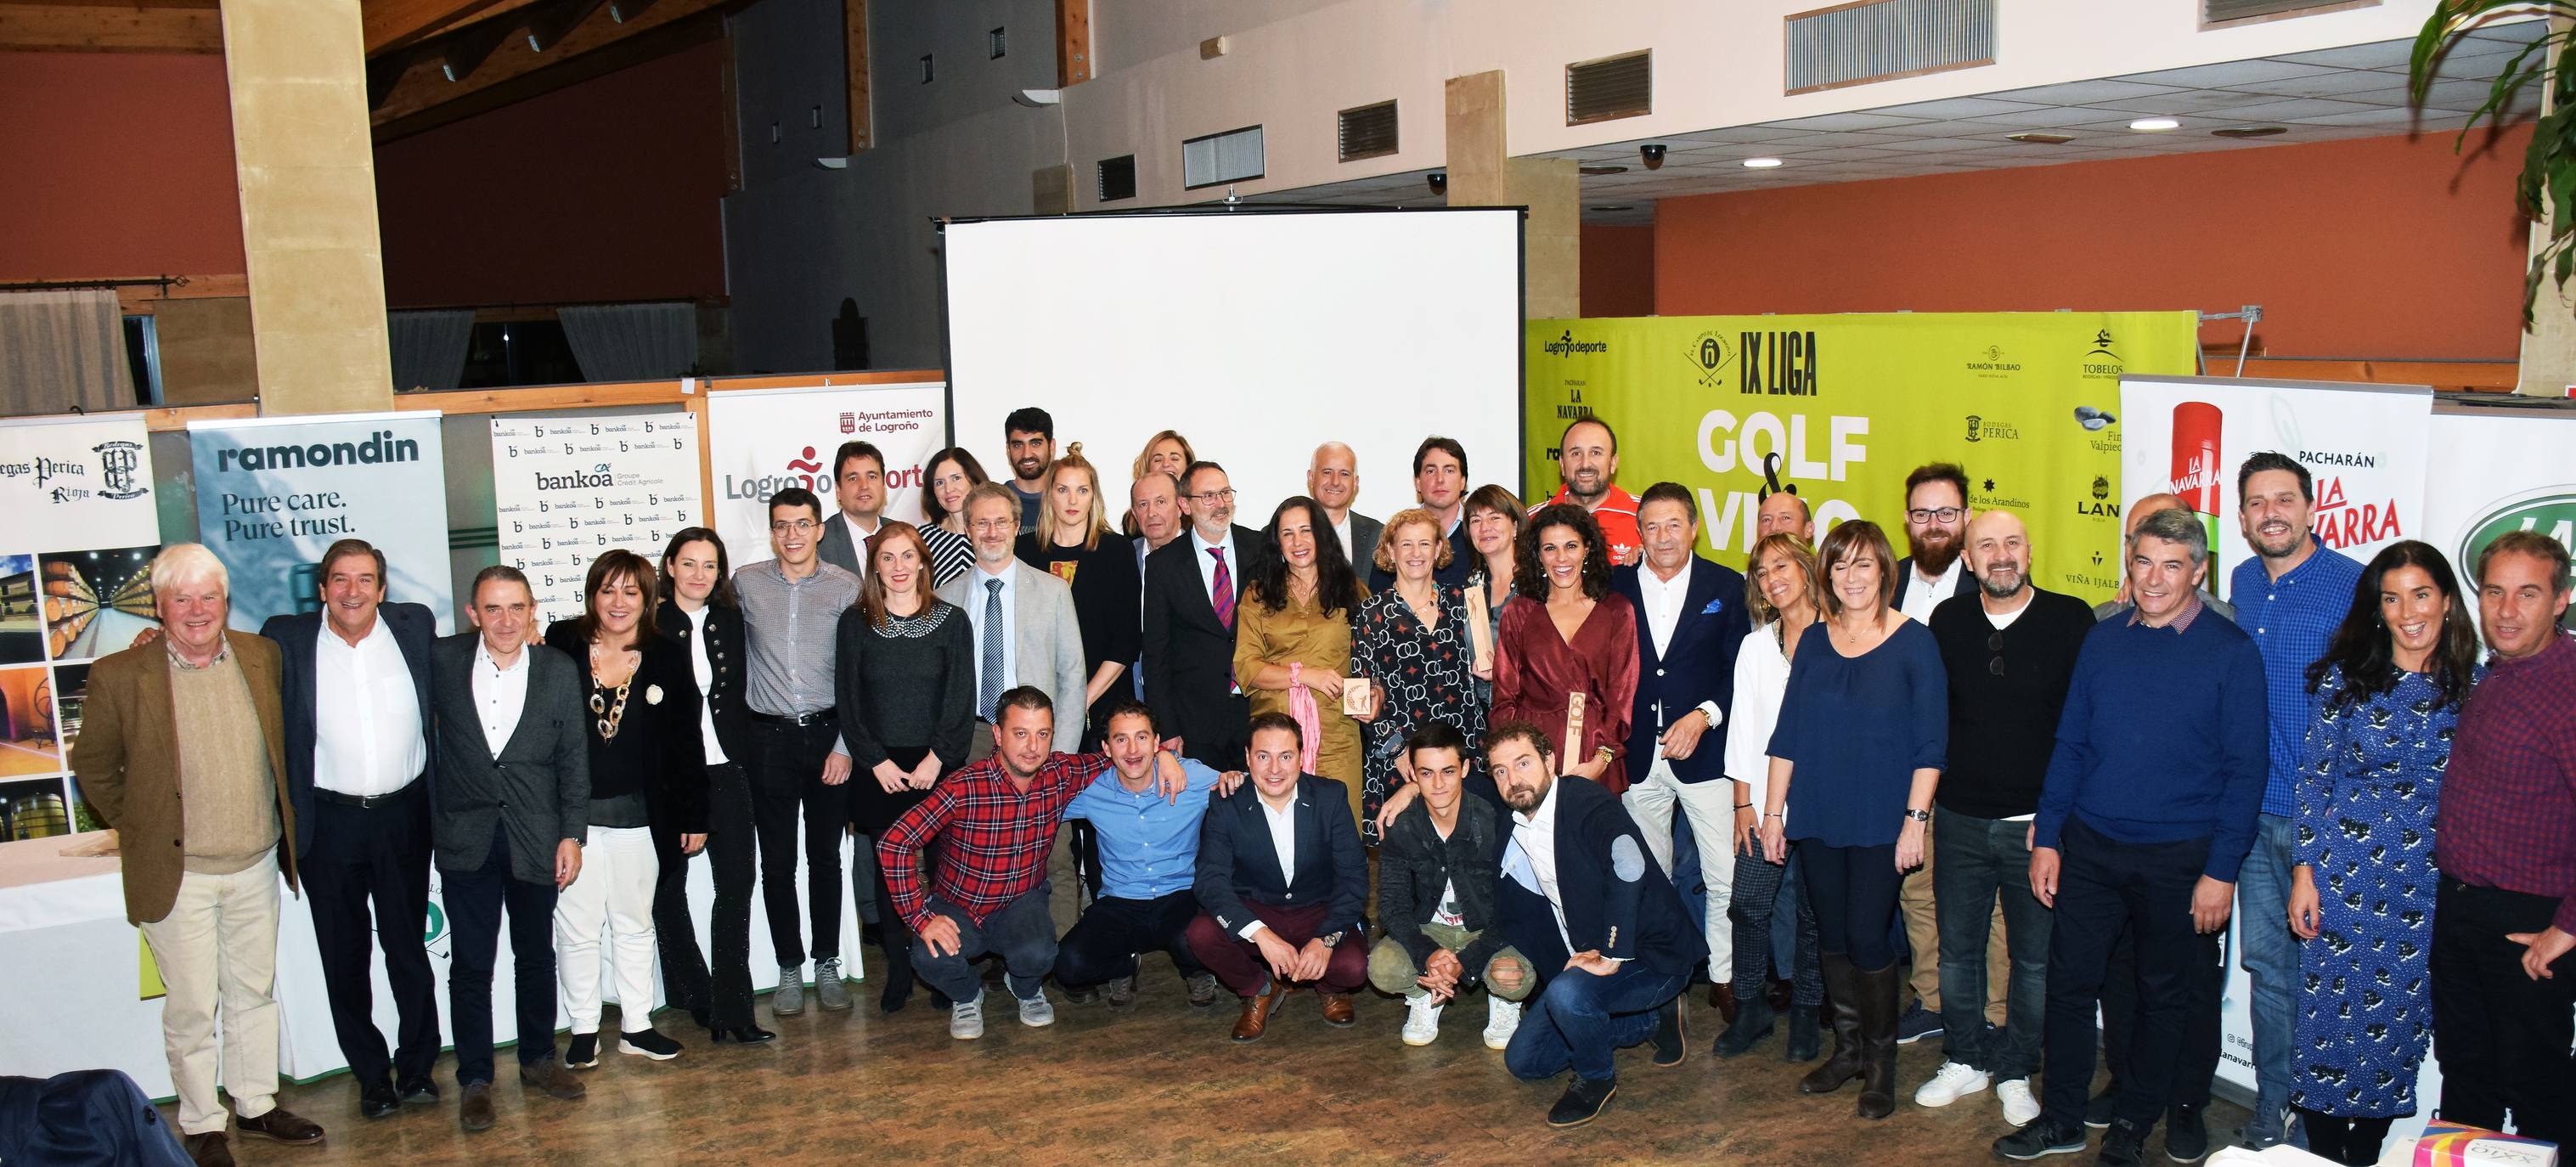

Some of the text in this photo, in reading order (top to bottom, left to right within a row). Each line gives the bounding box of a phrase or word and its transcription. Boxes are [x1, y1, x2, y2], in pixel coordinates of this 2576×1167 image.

[1740, 330, 1818, 397] IX LIGA
[2083, 364, 2123, 375] TOBELOS
[1570, 389, 1581, 403] LA
[858, 409, 933, 423] Ayuntamiento
[859, 421, 919, 434] de Logroño
[1983, 427, 2019, 440] PERICA
[2108, 431, 2122, 442] Fin
[218, 430, 420, 472] ramondin
[1697, 409, 1869, 482] GOLF
[2189, 455, 2201, 475] LA
[2299, 452, 2375, 468] PACHARÁN
[32, 456, 85, 489] Perica
[535, 470, 614, 491] bankoa
[638, 478, 663, 487] Agricole
[50, 486, 90, 504] Rioja
[1969, 494, 2030, 509] de los Arandinos
[2314, 476, 2348, 512] LA
[222, 491, 347, 516] Pure care.
[2077, 501, 2121, 518] LAN
[225, 514, 357, 541] Pure trust.
[2066, 573, 2120, 589] VIÑA IJALB
[2221, 1051, 2257, 1070] anavarr
